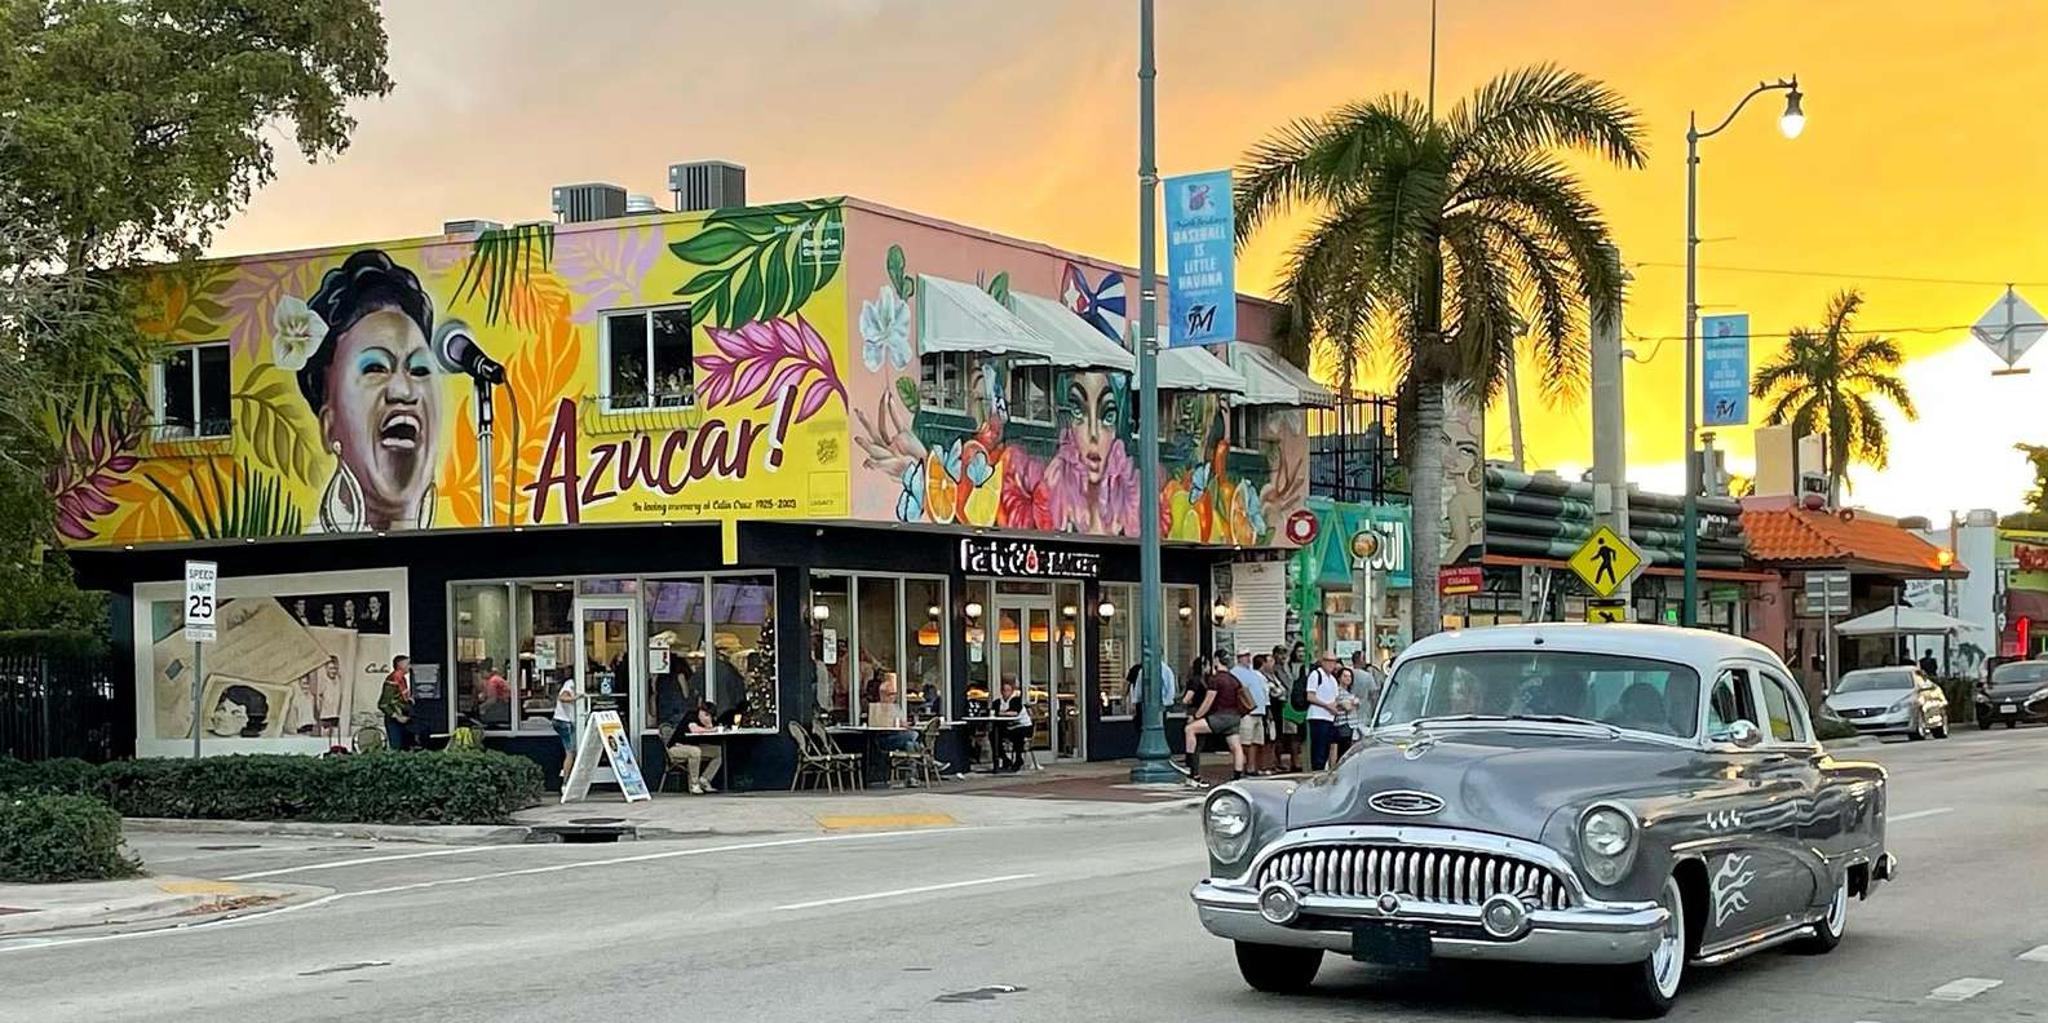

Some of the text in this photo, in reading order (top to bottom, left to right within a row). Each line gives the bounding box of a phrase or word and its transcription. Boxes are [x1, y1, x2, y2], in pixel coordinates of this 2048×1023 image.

[1173, 225, 1226, 245] BASEBALL
[1184, 257, 1216, 274] LITTLE
[1179, 271, 1223, 290] HAVANA
[523, 384, 798, 524] Azúcar!
[643, 502, 667, 515] loving
[189, 569, 213, 580] SPEED
[191, 583, 211, 592] LIMIT
[189, 594, 212, 618] 25
